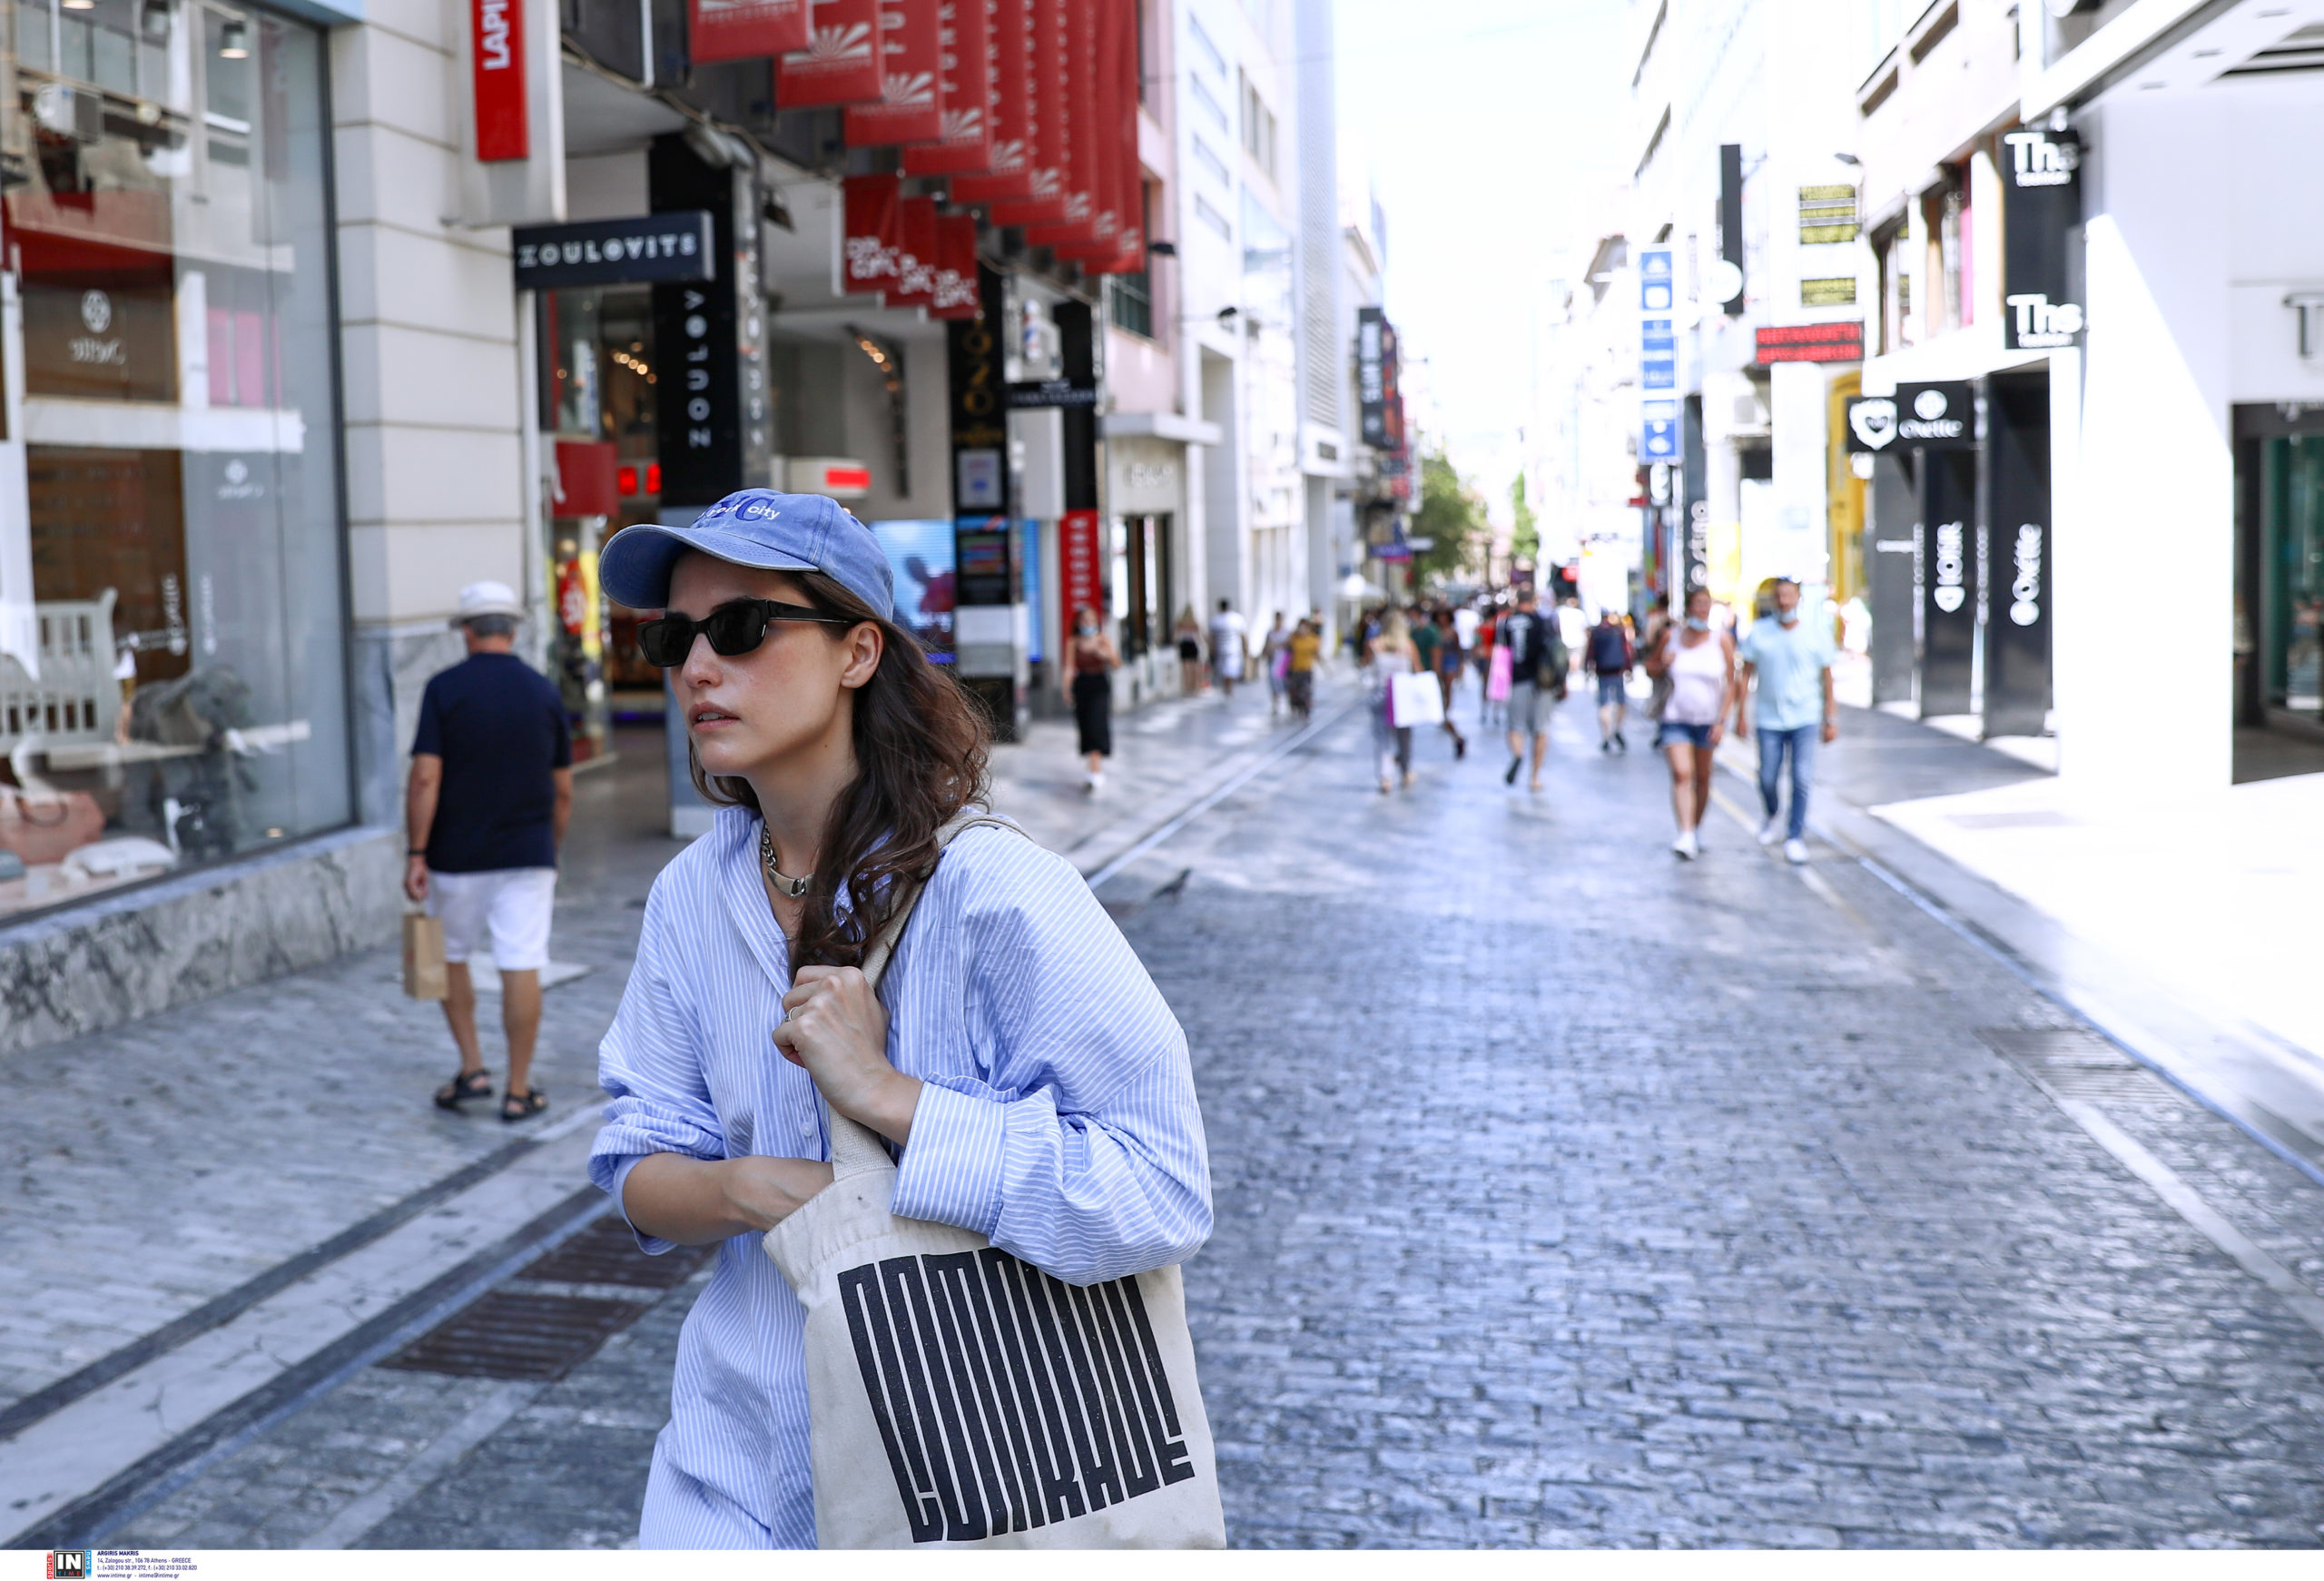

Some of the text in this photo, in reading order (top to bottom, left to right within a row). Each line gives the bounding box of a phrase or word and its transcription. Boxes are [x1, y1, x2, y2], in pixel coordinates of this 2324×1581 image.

[480, 0, 510, 70] LAPI
[517, 232, 697, 268] ZOULOVITS
[684, 290, 712, 449] ZOULOV
[747, 506, 781, 520] city
